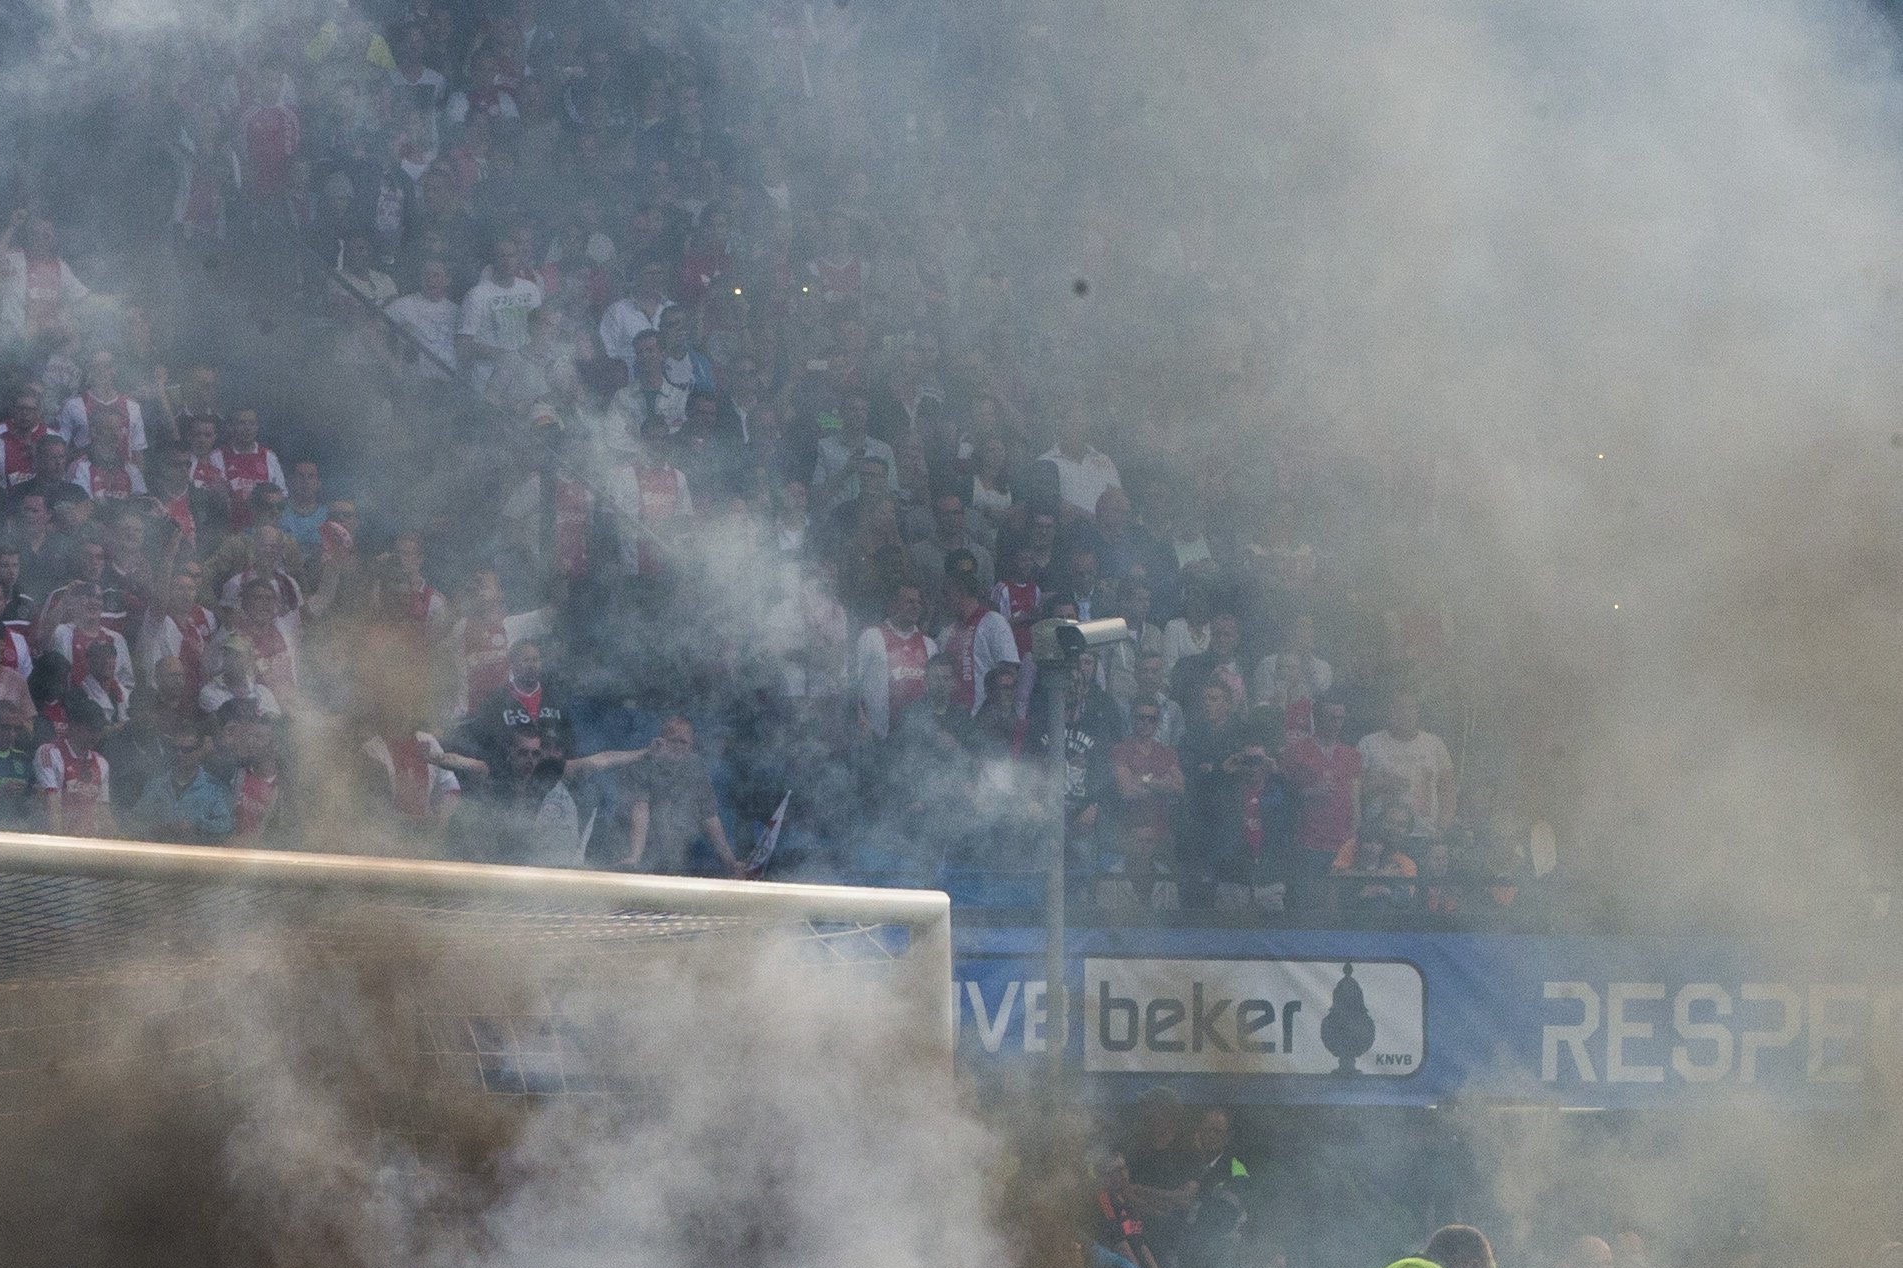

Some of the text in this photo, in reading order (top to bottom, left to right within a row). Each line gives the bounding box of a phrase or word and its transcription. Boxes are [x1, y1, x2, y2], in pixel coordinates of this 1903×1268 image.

[952, 980, 1070, 1053] VB
[1099, 980, 1302, 1056] beker
[1375, 1053, 1413, 1066] KNVB
